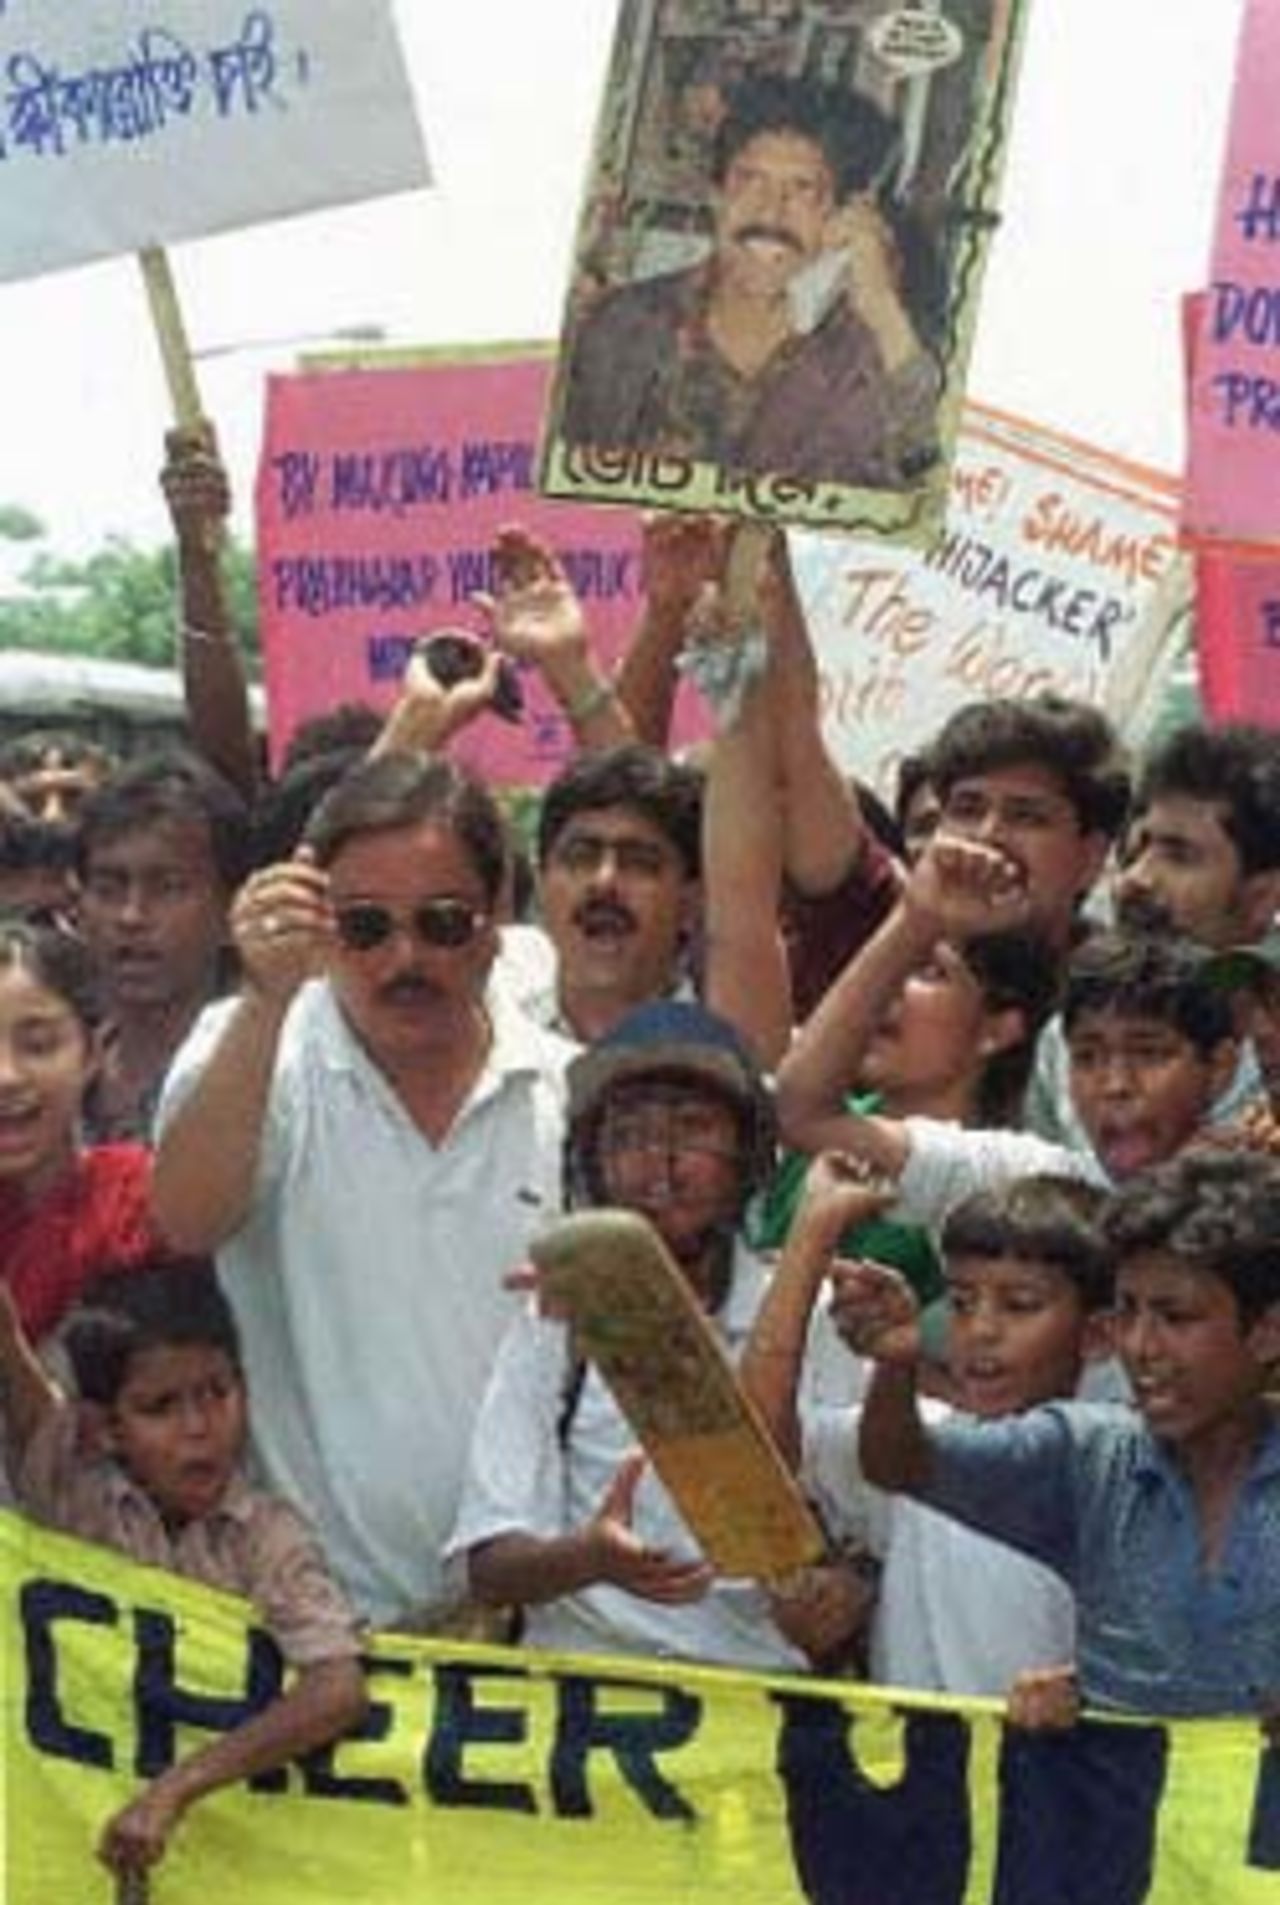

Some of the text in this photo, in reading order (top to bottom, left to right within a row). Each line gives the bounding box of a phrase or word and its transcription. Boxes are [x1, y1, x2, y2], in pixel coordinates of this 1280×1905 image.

[1211, 282, 1280, 345] DO
[1021, 491, 1176, 588] SHAME
[842, 568, 935, 656] The
[19, 1577, 702, 1822] CHEER
